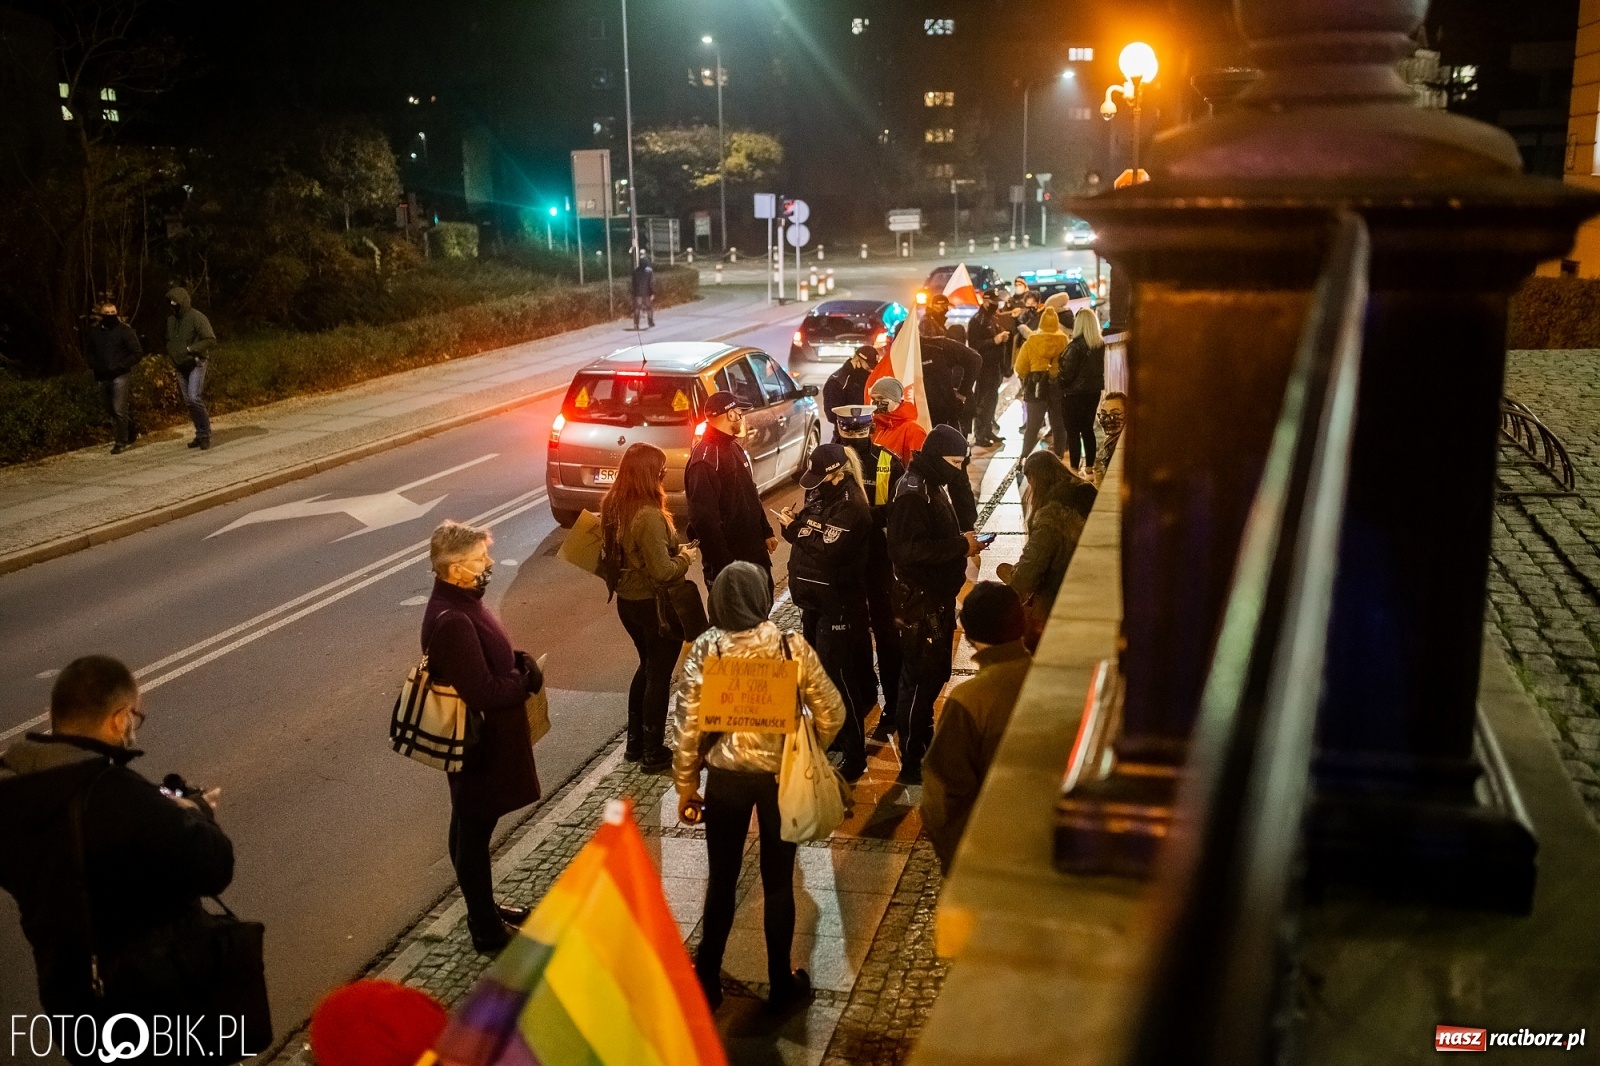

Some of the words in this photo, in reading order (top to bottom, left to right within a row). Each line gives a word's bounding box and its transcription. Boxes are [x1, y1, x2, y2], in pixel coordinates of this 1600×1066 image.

[825, 461, 841, 472] POLICJA
[806, 518, 822, 529] POLICJA
[728, 678, 740, 691] ZA
[721, 692, 734, 705] DO
[704, 715, 722, 725] NAM
